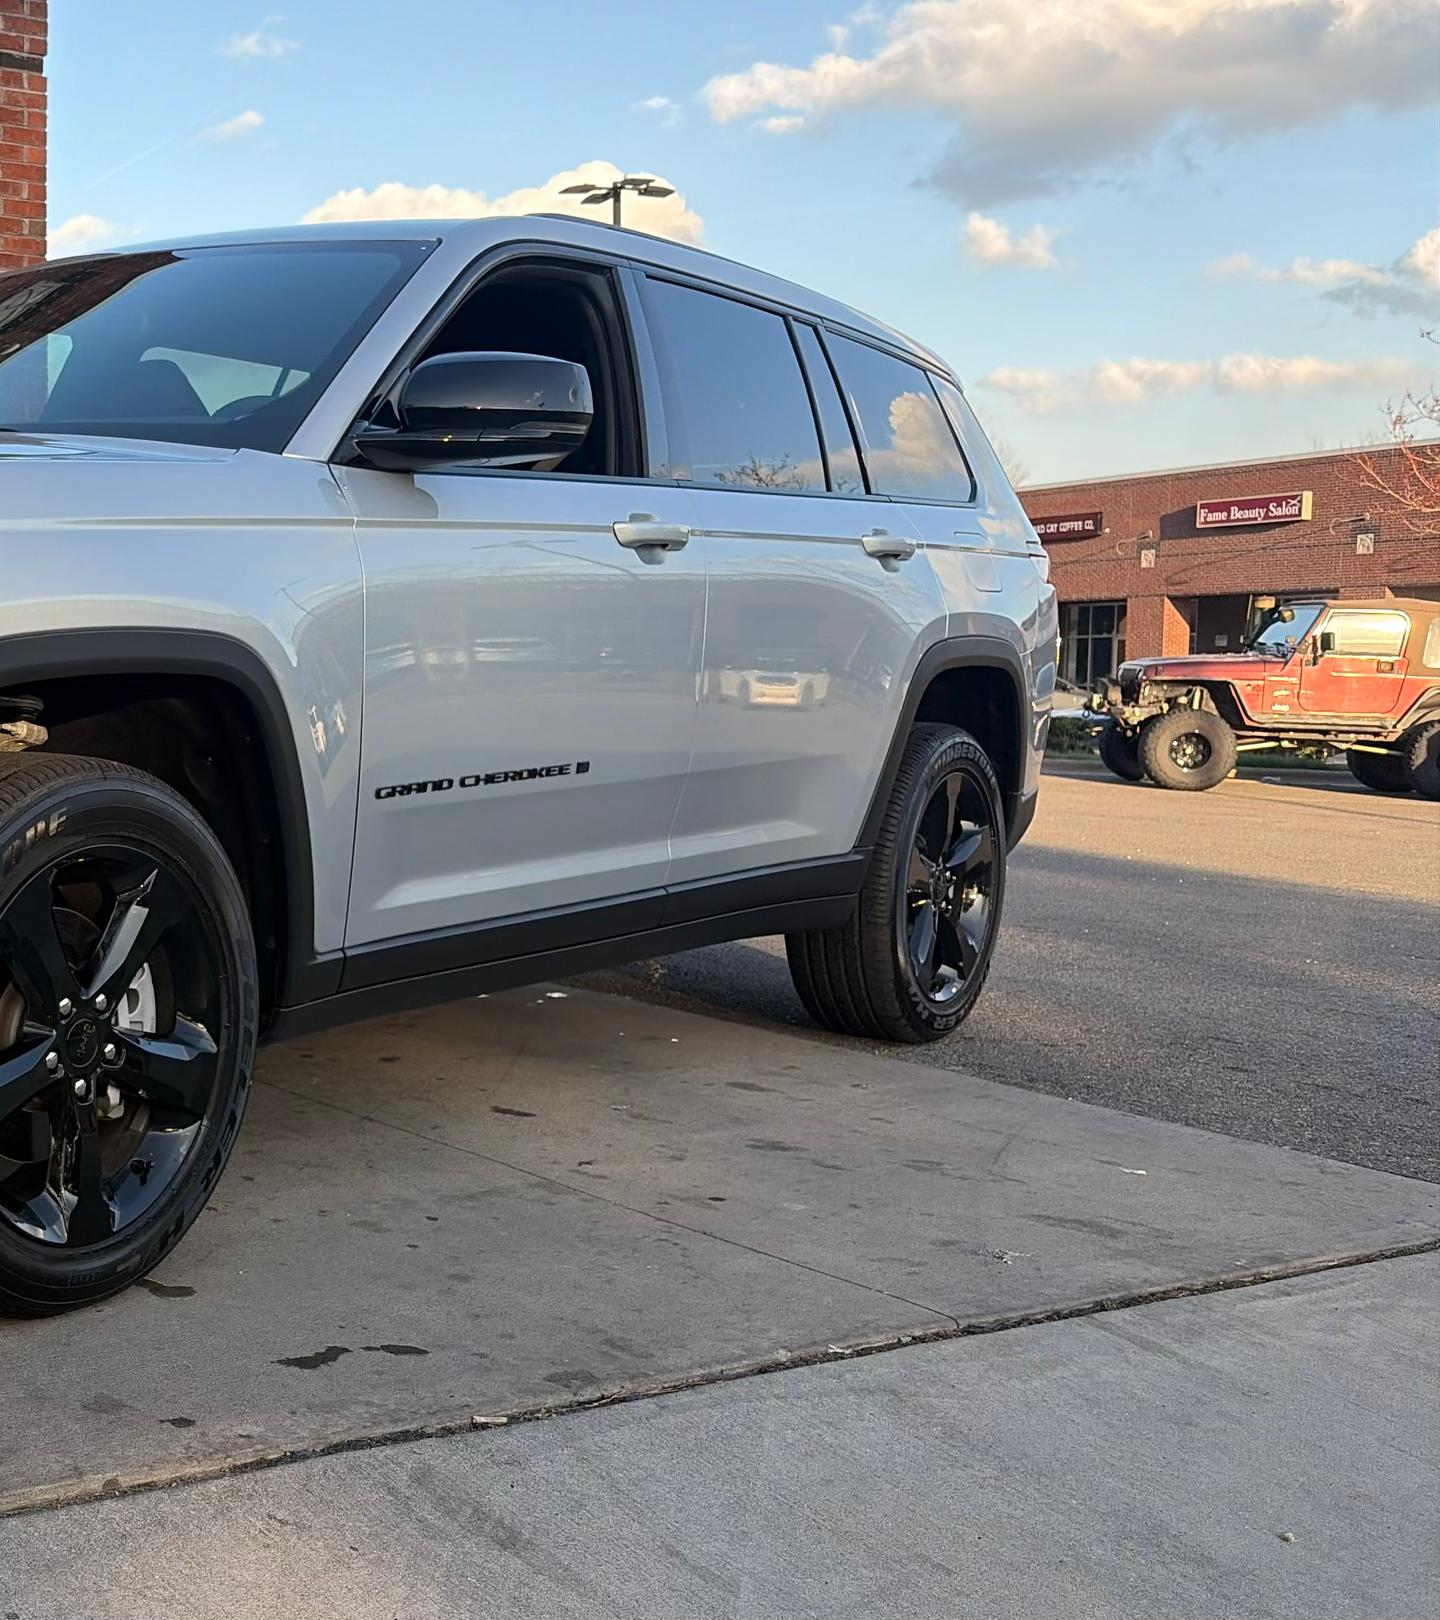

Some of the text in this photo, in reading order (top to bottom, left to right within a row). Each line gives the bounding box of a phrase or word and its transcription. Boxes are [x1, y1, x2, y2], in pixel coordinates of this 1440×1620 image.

[1200, 501, 1299, 522] Fame Beauty Salon
[1046, 523, 1058, 533] CAT
[1060, 521, 1083, 532] COFFEE
[375, 764, 573, 799] GRAND CHEROKEE
